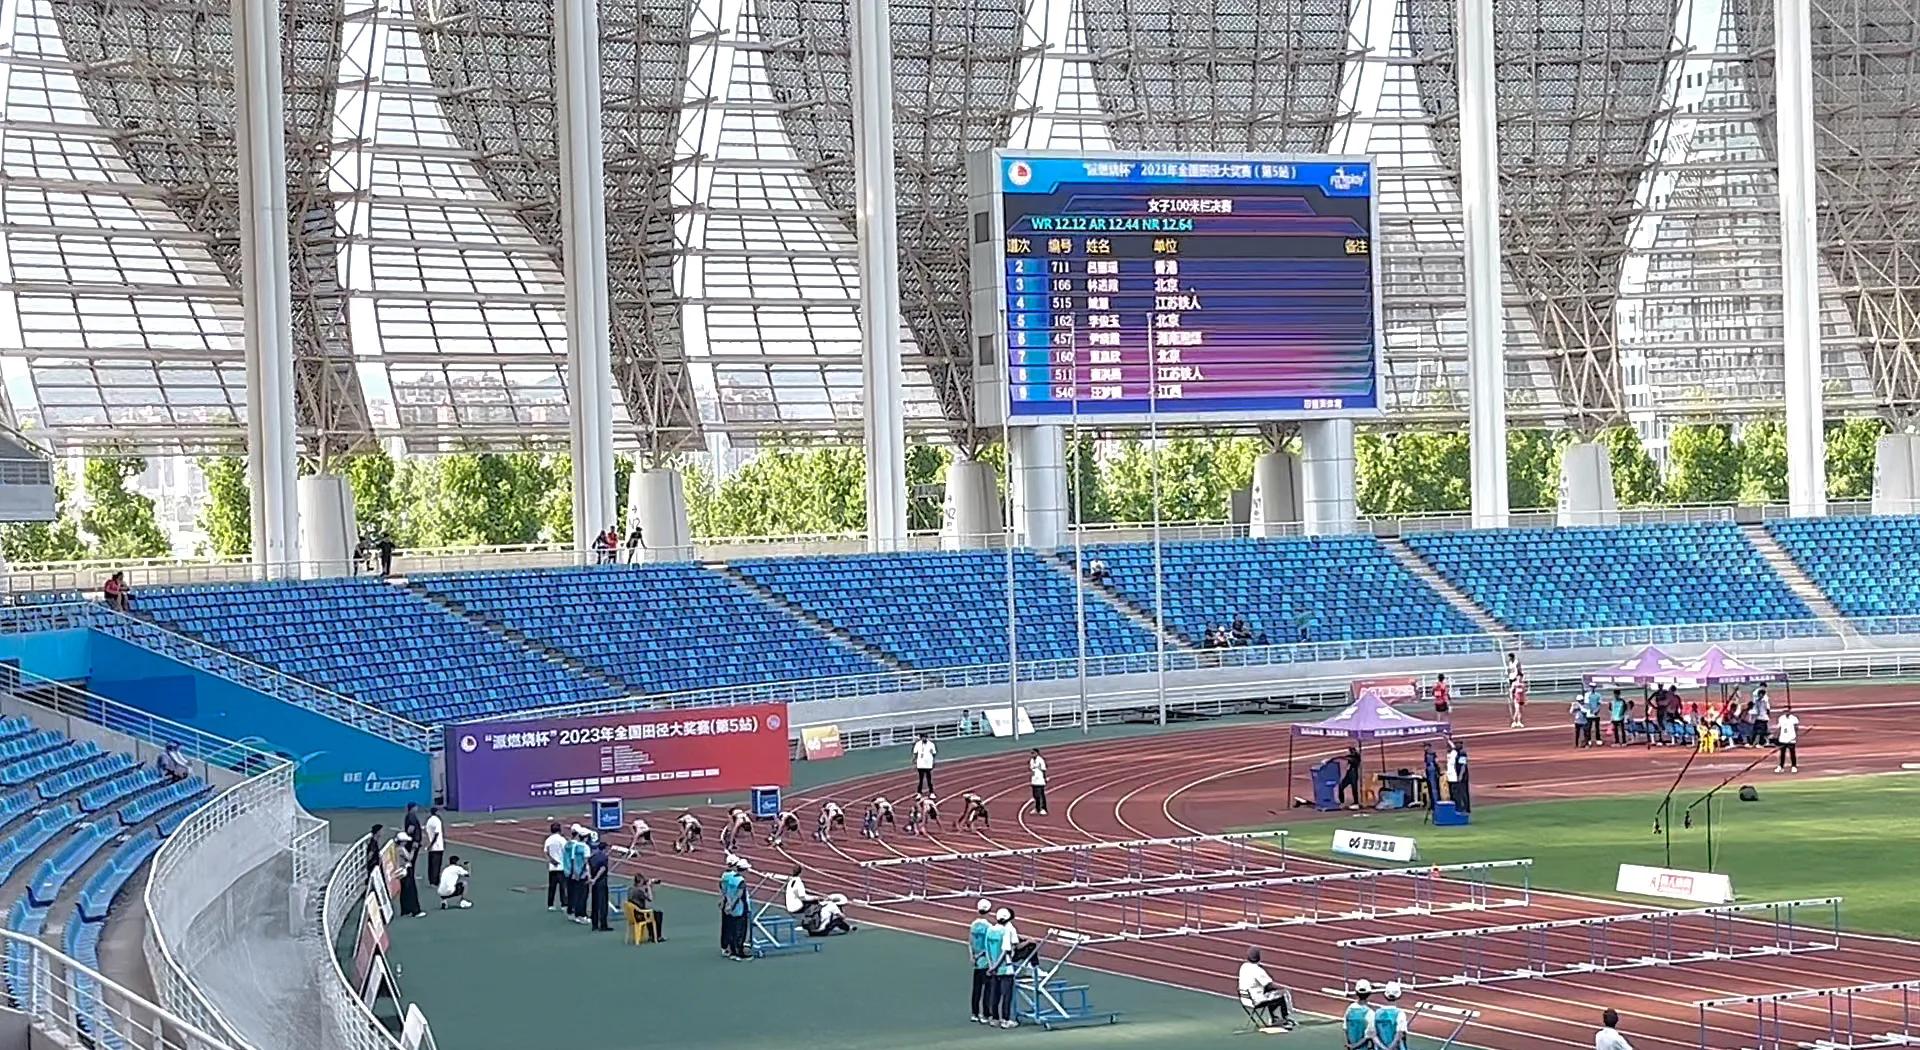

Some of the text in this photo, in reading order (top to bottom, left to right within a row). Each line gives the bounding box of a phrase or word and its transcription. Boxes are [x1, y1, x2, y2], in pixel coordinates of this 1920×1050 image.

[1148, 198, 1232, 213] 女子100米栏决赛
[1031, 217, 1192, 230] WR 12.12 AR 12.44 NR 12.64
[1048, 238, 1072, 253] 编号
[1086, 238, 1110, 253] 姓名
[1153, 238, 1177, 253] 单位
[1345, 239, 1368, 254] 备注
[1015, 261, 1023, 273] 2
[1051, 261, 1069, 273] 711
[1016, 280, 1024, 291] 3
[1155, 278, 1178, 292] 北京
[1017, 297, 1024, 309] 4
[1053, 297, 1072, 309] 515
[1055, 315, 1073, 327] 162
[1156, 313, 1180, 328] 北京
[1054, 333, 1073, 345] 457
[1018, 349, 1181, 363] 7 160 北京
[1055, 369, 1073, 381] 511
[1056, 387, 1074, 399] 540
[343, 771, 377, 783] BE A
[365, 780, 420, 792] LEADER
